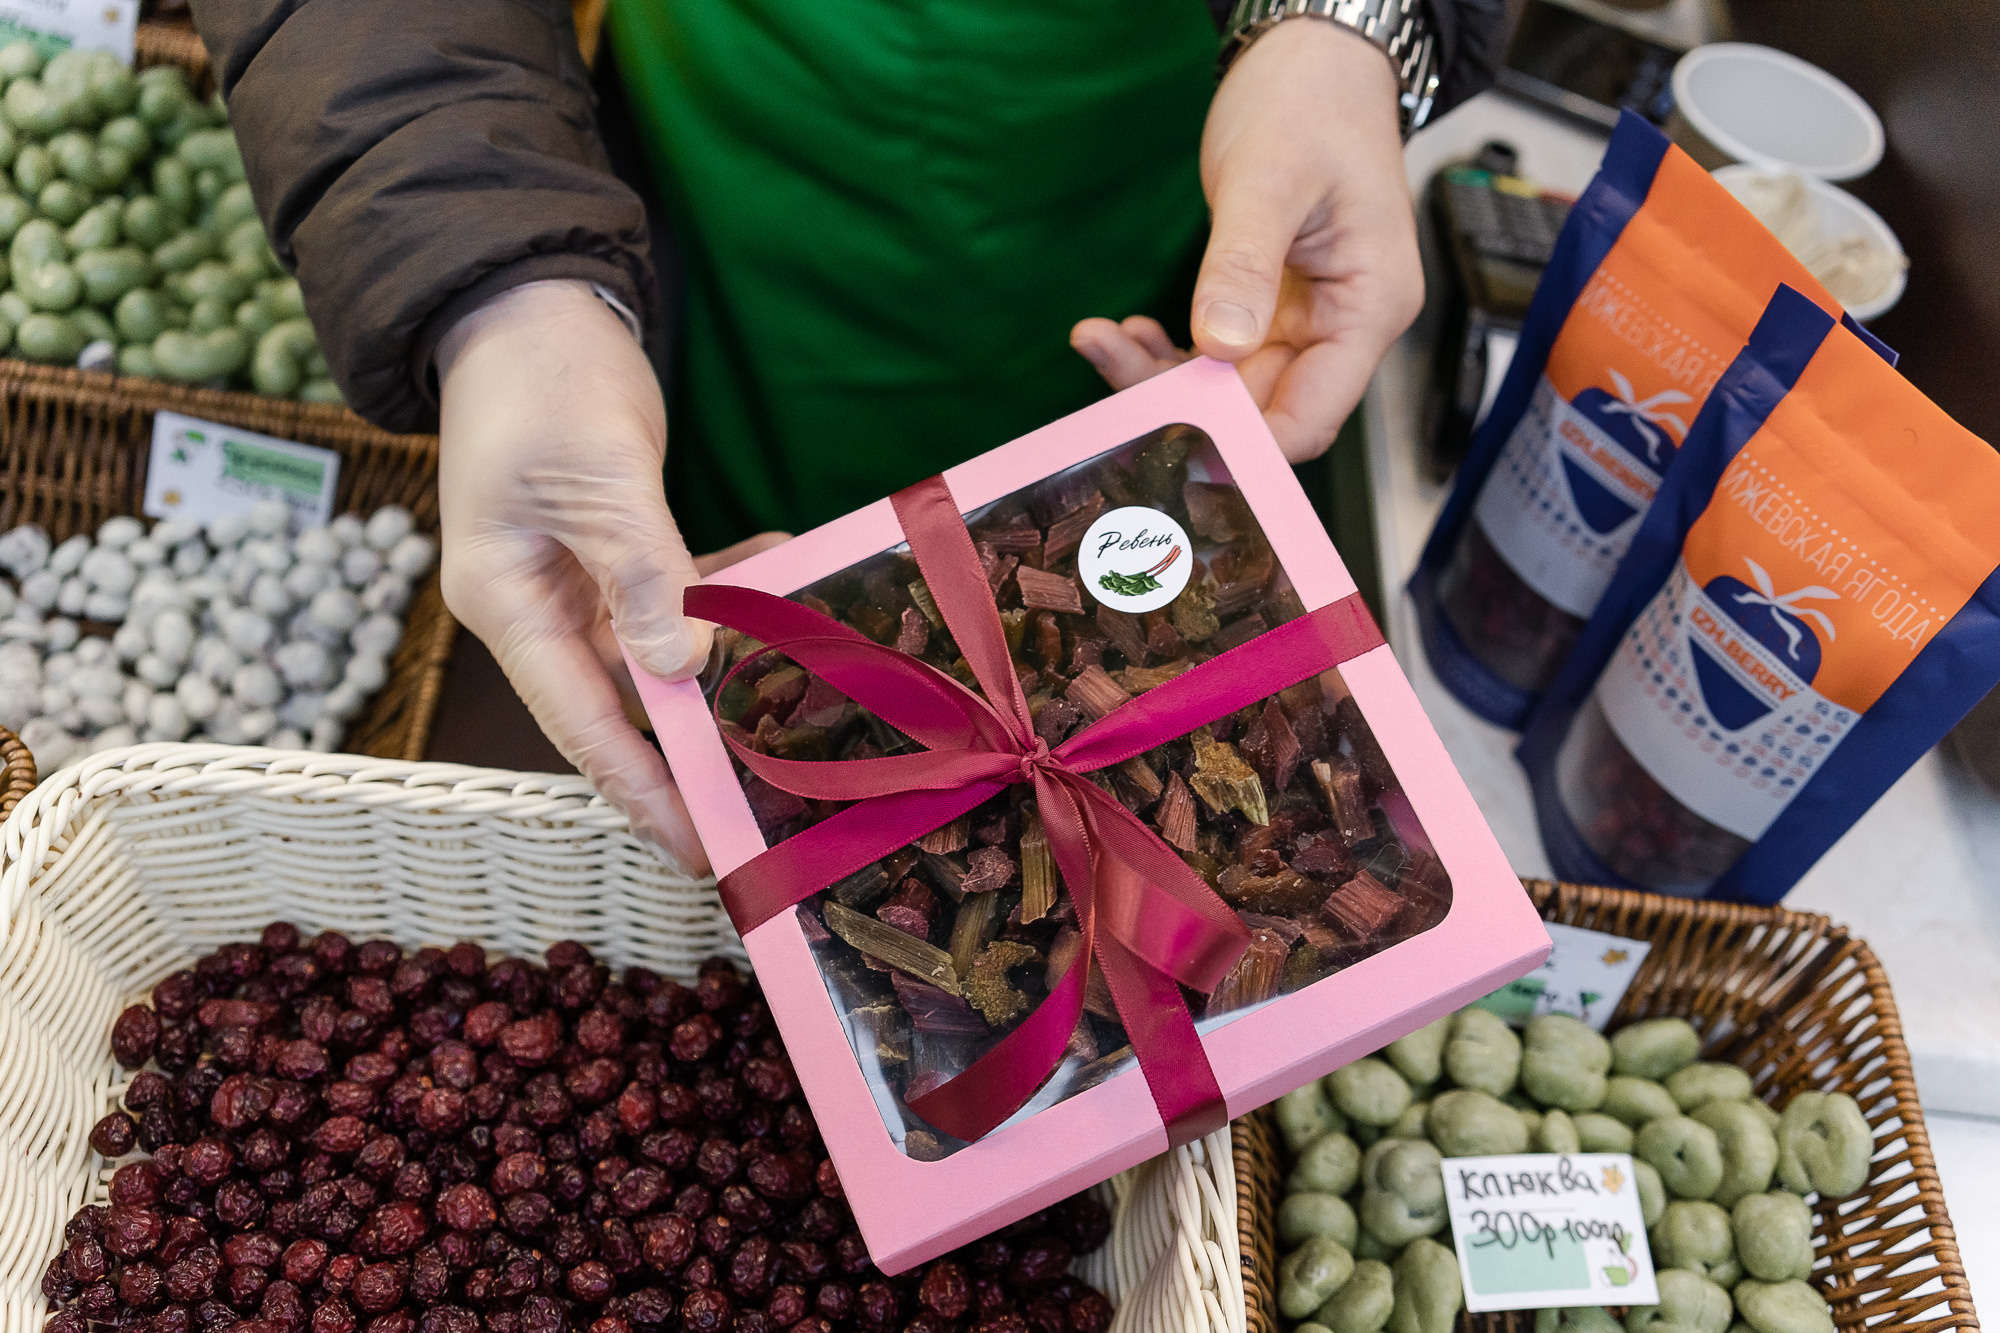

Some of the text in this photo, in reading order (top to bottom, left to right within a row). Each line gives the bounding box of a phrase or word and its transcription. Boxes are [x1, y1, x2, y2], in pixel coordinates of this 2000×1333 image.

[1097, 528, 1174, 559] Ревень
[1721, 463, 1931, 650] ИЖЕВСКАЯ ЯГОДА
